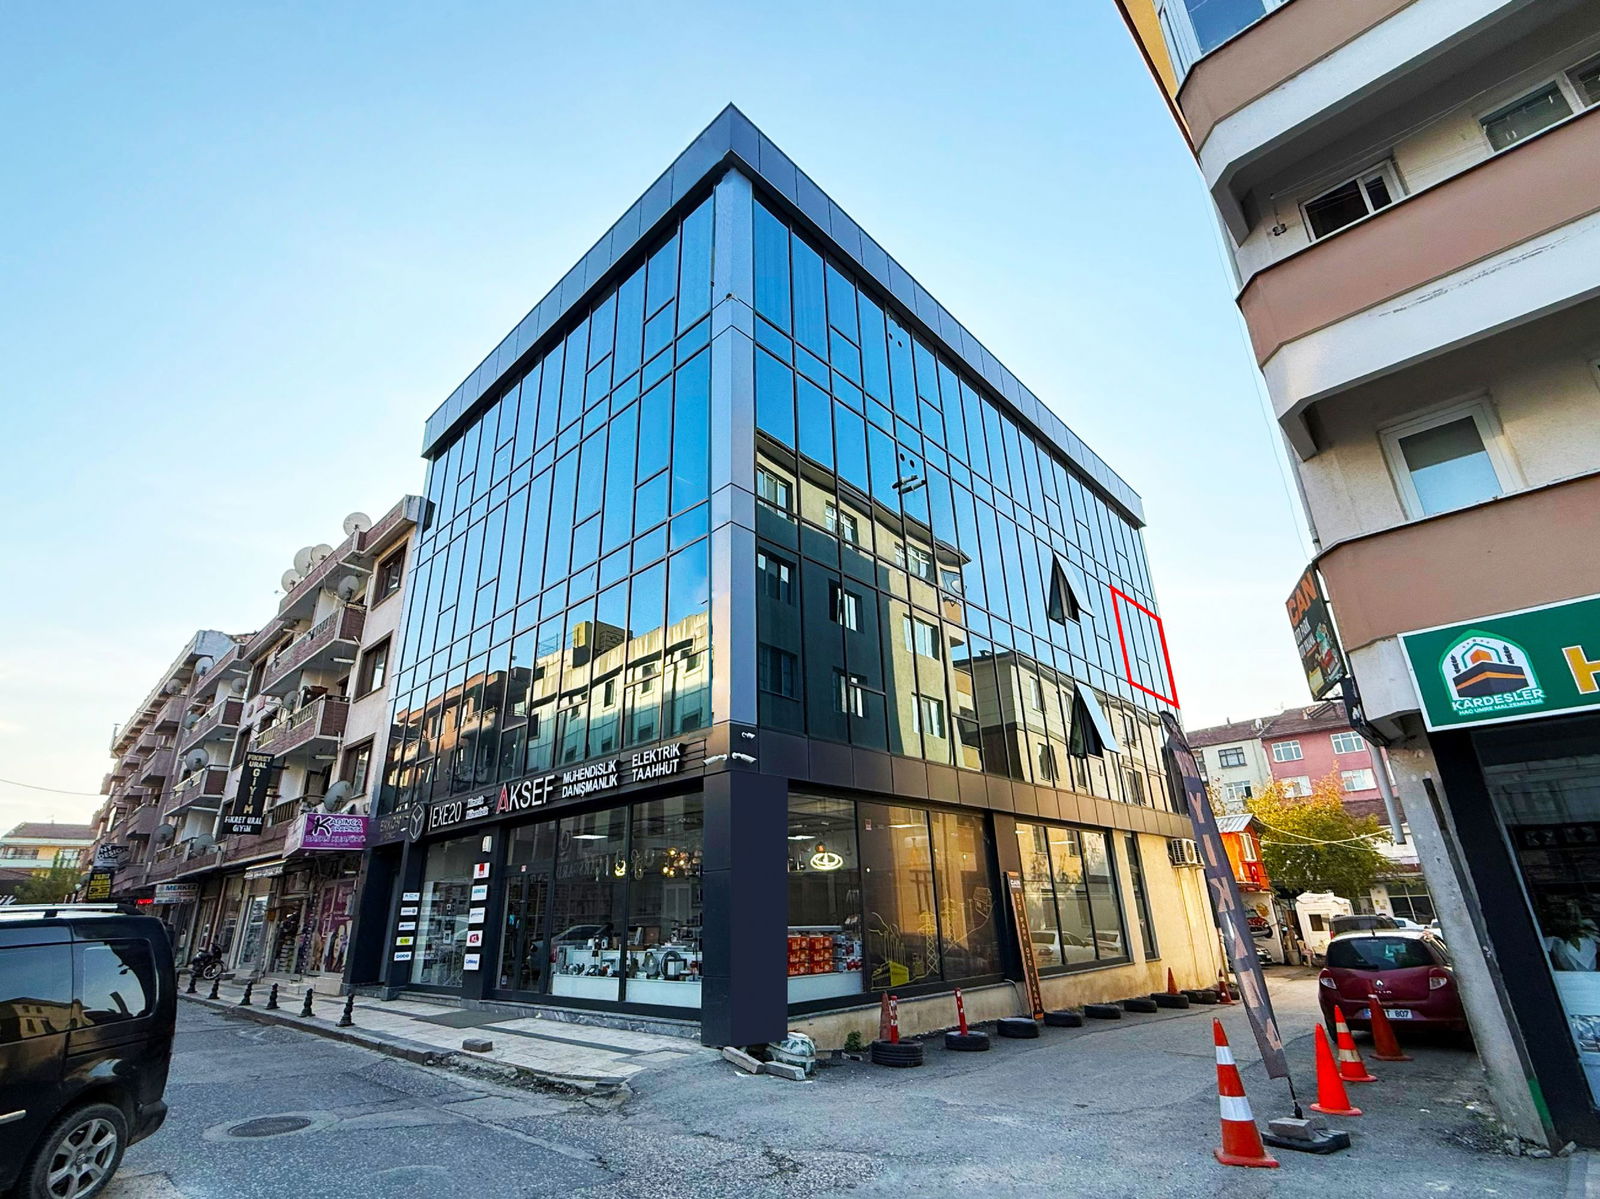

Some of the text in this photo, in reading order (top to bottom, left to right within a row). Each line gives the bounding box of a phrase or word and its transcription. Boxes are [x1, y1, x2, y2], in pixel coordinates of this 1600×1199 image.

[1287, 572, 1317, 627] CAN
[632, 743, 681, 767] ELEKTRİK
[563, 760, 617, 784] MÜHENDİSLİK
[632, 759, 680, 782] TAAHHÜT
[496, 775, 555, 814] AKSEF
[562, 774, 618, 798] DANIŞMANLIK
